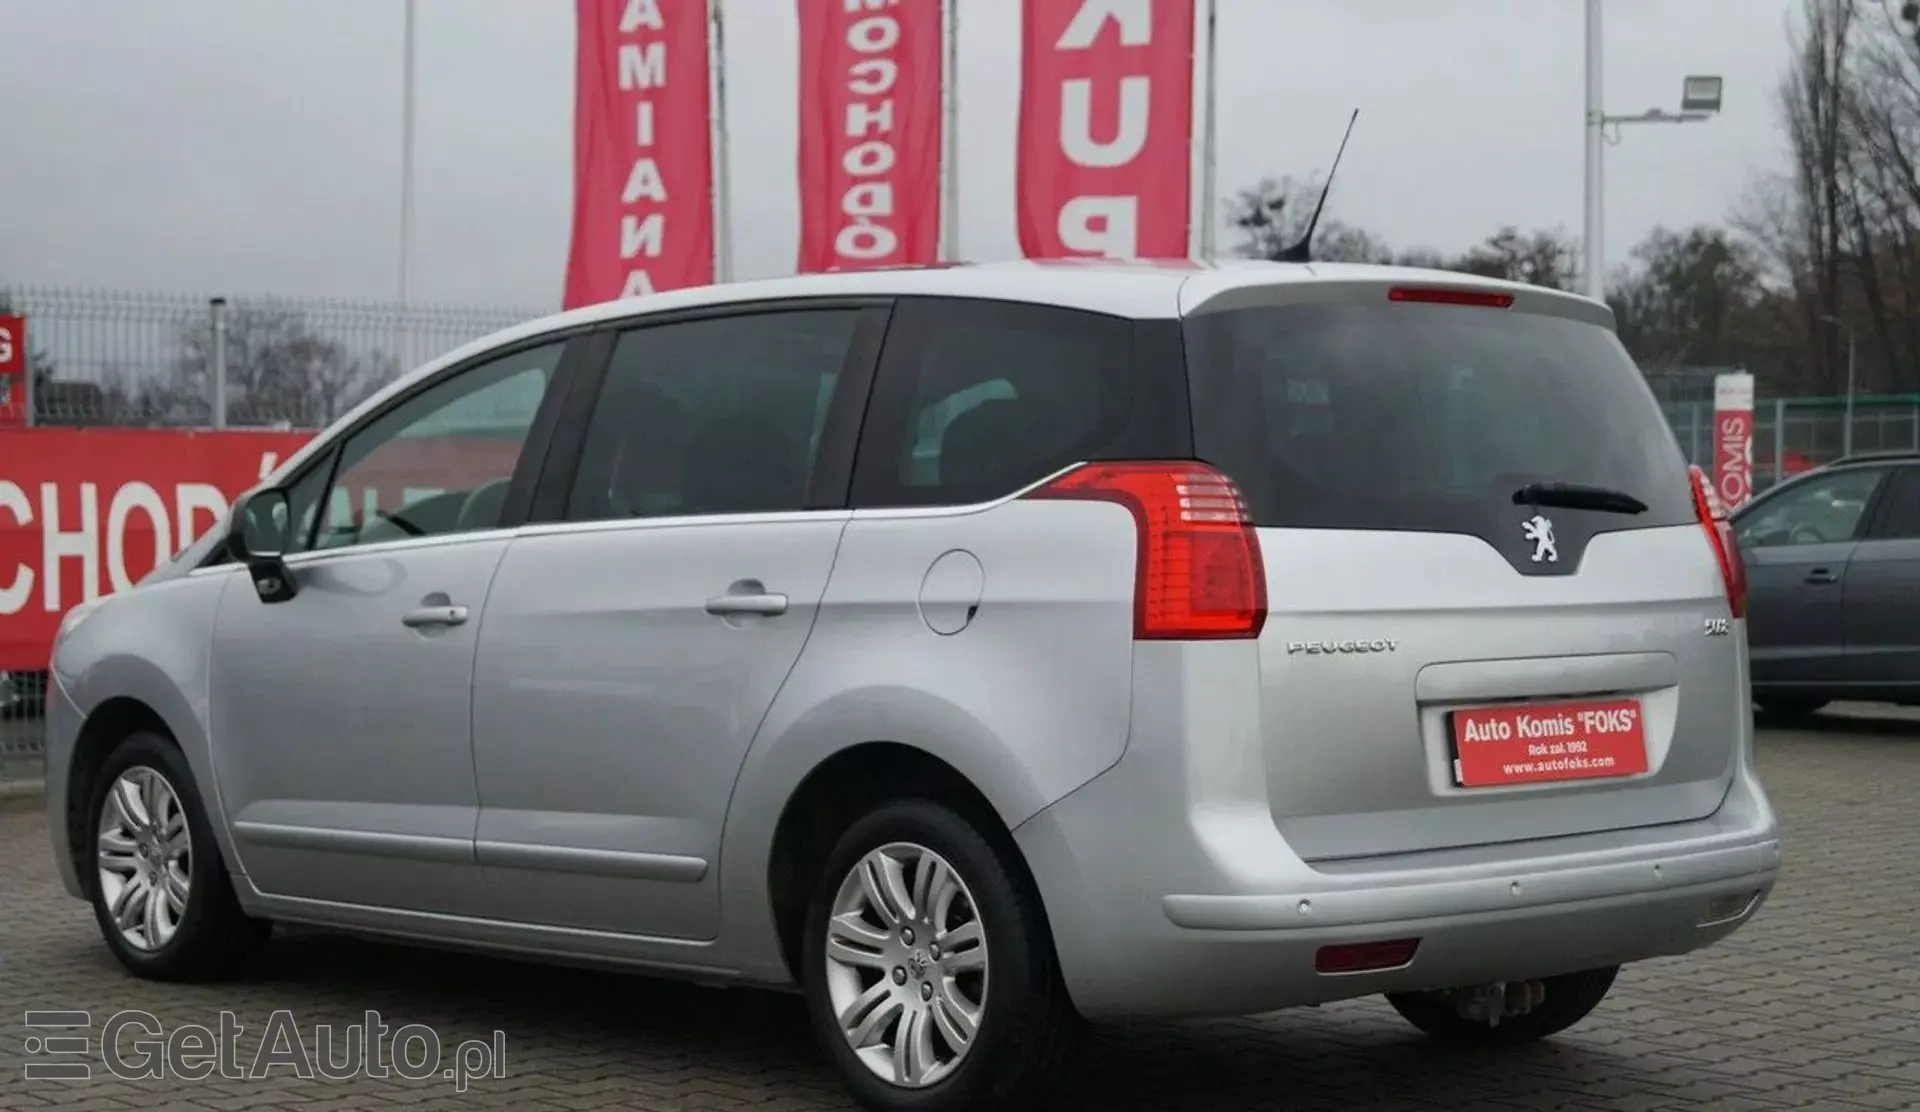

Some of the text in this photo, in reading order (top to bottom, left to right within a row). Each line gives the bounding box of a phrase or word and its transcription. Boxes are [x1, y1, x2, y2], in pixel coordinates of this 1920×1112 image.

[1286, 639, 1398, 655] PEUGEOT
[1464, 708, 1637, 742] Auto Komis "FOKS"
[1528, 743, 1548, 756] Rok
[1503, 756, 1615, 775] www.autofoks.com
